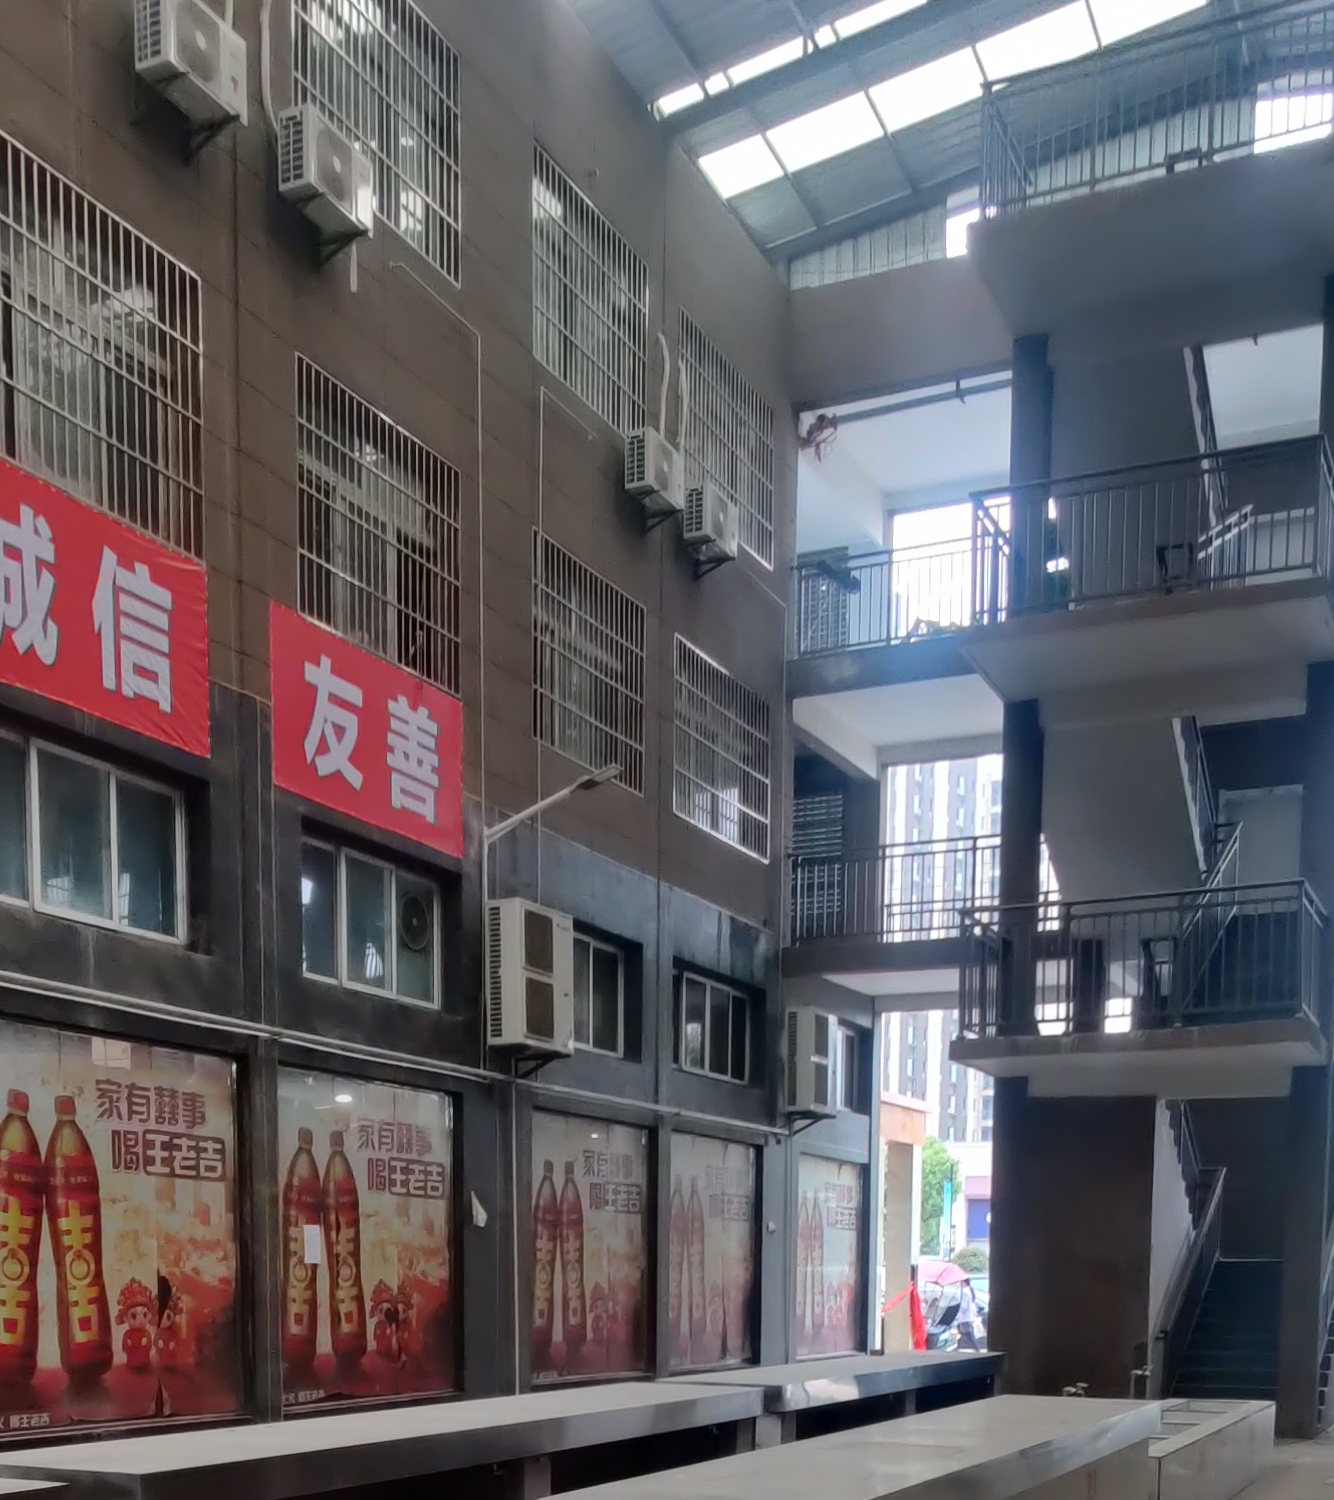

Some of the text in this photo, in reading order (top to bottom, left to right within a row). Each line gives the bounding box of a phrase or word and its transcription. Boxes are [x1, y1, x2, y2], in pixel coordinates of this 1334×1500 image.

[303, 654, 440, 824] 友善
[110, 1128, 226, 1182] 喝王老吉
